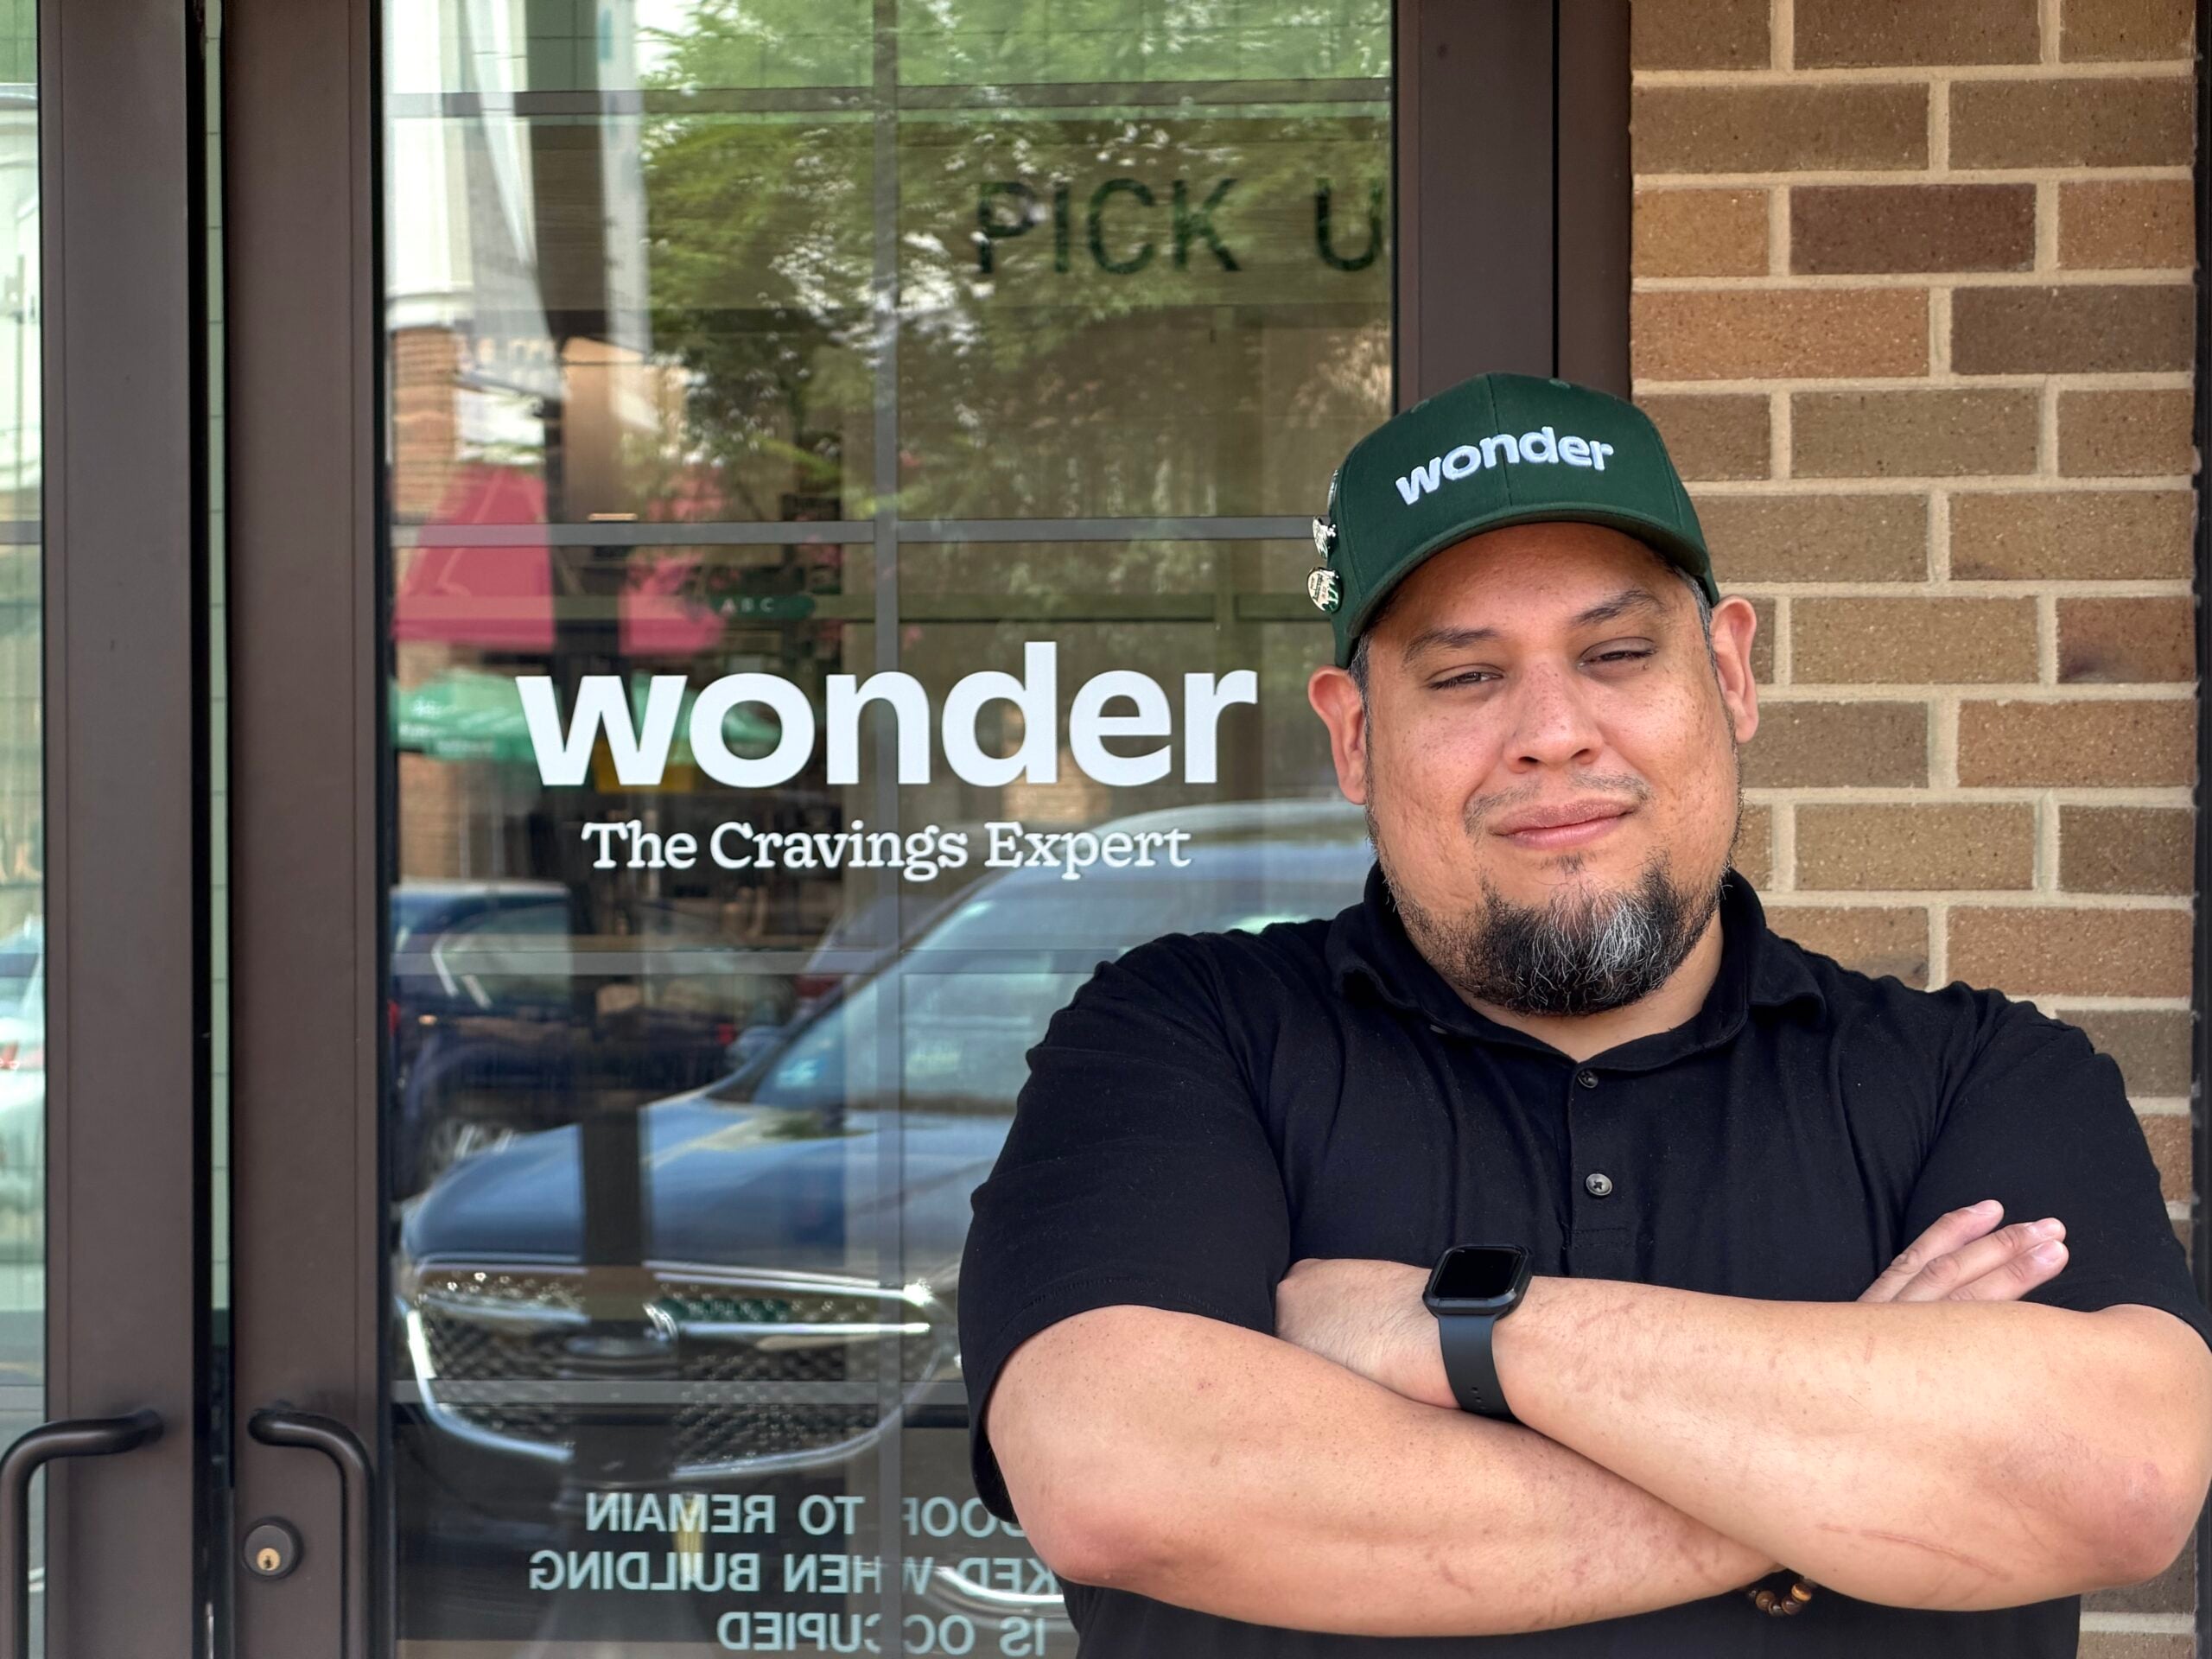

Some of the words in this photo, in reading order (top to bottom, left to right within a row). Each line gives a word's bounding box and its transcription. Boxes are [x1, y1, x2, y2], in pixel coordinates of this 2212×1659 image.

[976, 177, 1242, 274] PICK
[1395, 426, 1614, 505] wonder
[516, 642, 1257, 787] wonder
[581, 820, 697, 869] The
[710, 819, 969, 882] Cravings
[984, 821, 1192, 880] Expert
